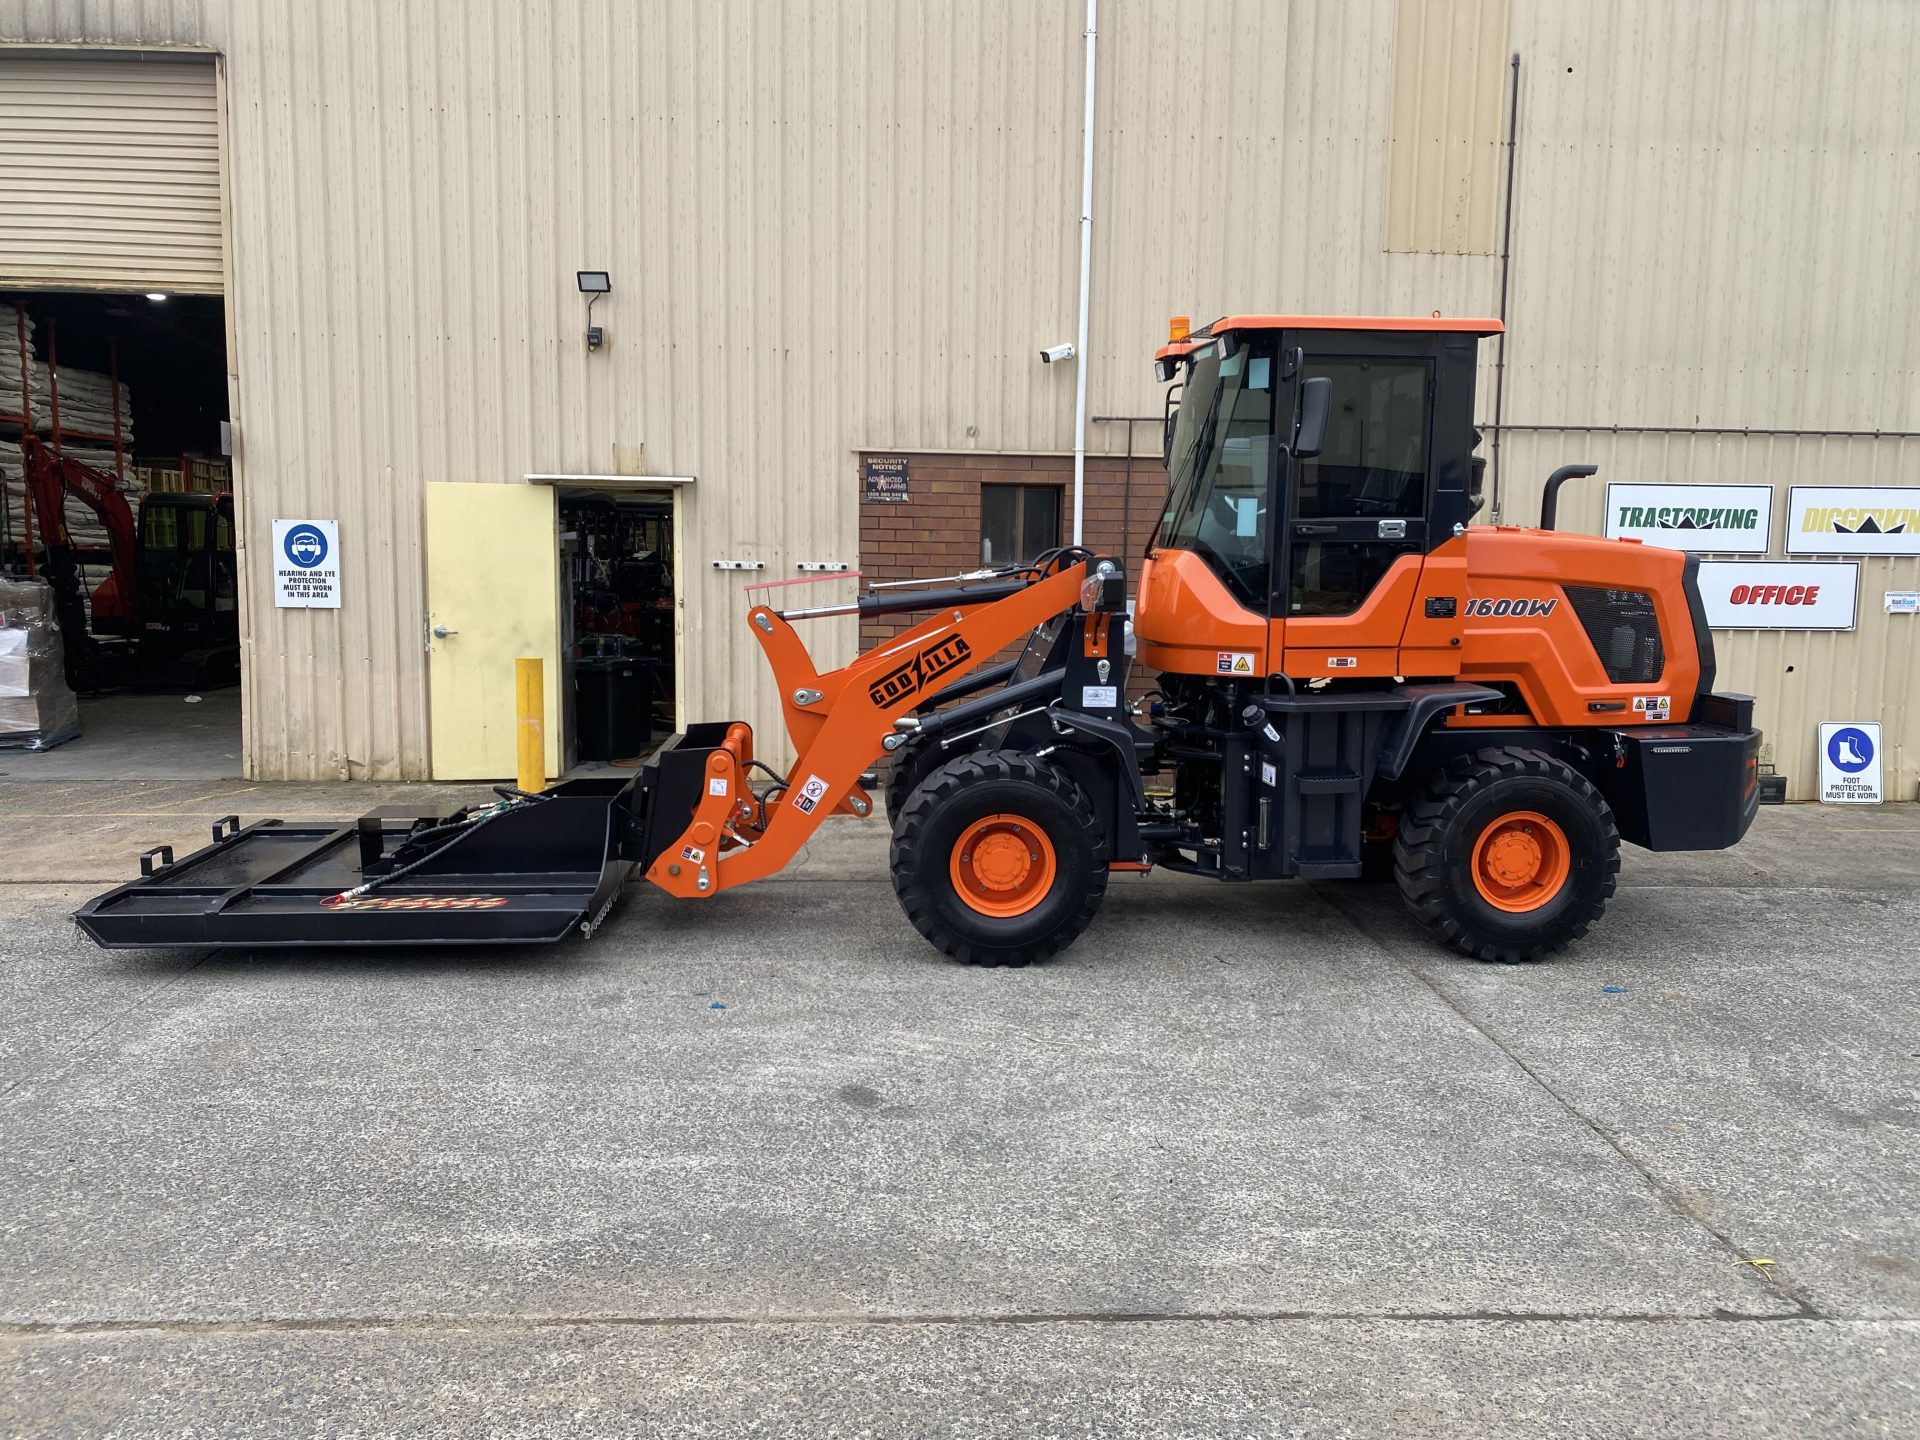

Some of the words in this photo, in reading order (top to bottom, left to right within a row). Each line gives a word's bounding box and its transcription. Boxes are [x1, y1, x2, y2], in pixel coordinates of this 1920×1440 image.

[1618, 507, 1759, 530] TRACTORKING
[1729, 584, 1821, 606] OFFICE
[1463, 598, 1559, 618] 1600W
[868, 637, 972, 707] GODZILLA
